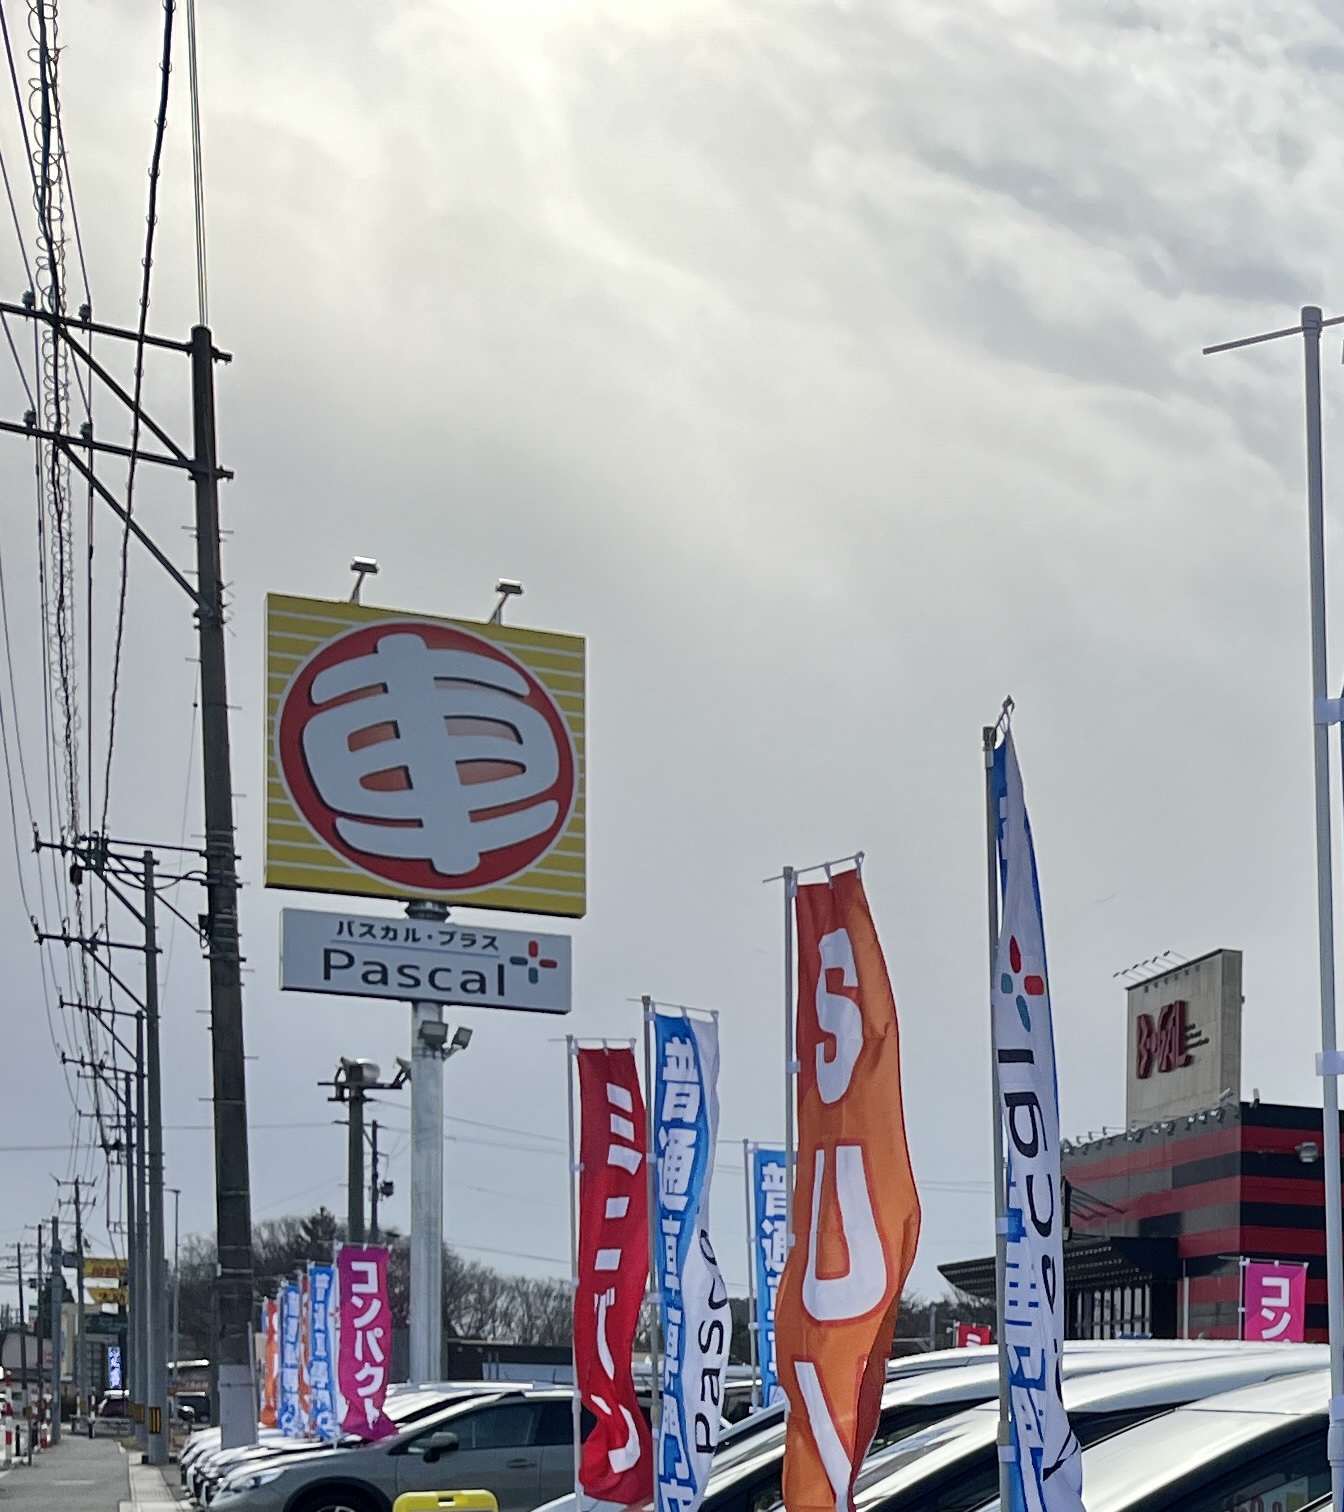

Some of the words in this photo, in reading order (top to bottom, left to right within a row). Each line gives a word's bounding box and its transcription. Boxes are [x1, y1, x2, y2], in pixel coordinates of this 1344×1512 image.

[335, 918, 500, 952] パスカル・プラス
[322, 947, 507, 998] Pascal
[1261, 1276, 1292, 1342] コン
[351, 1261, 386, 1430] コンパクト
